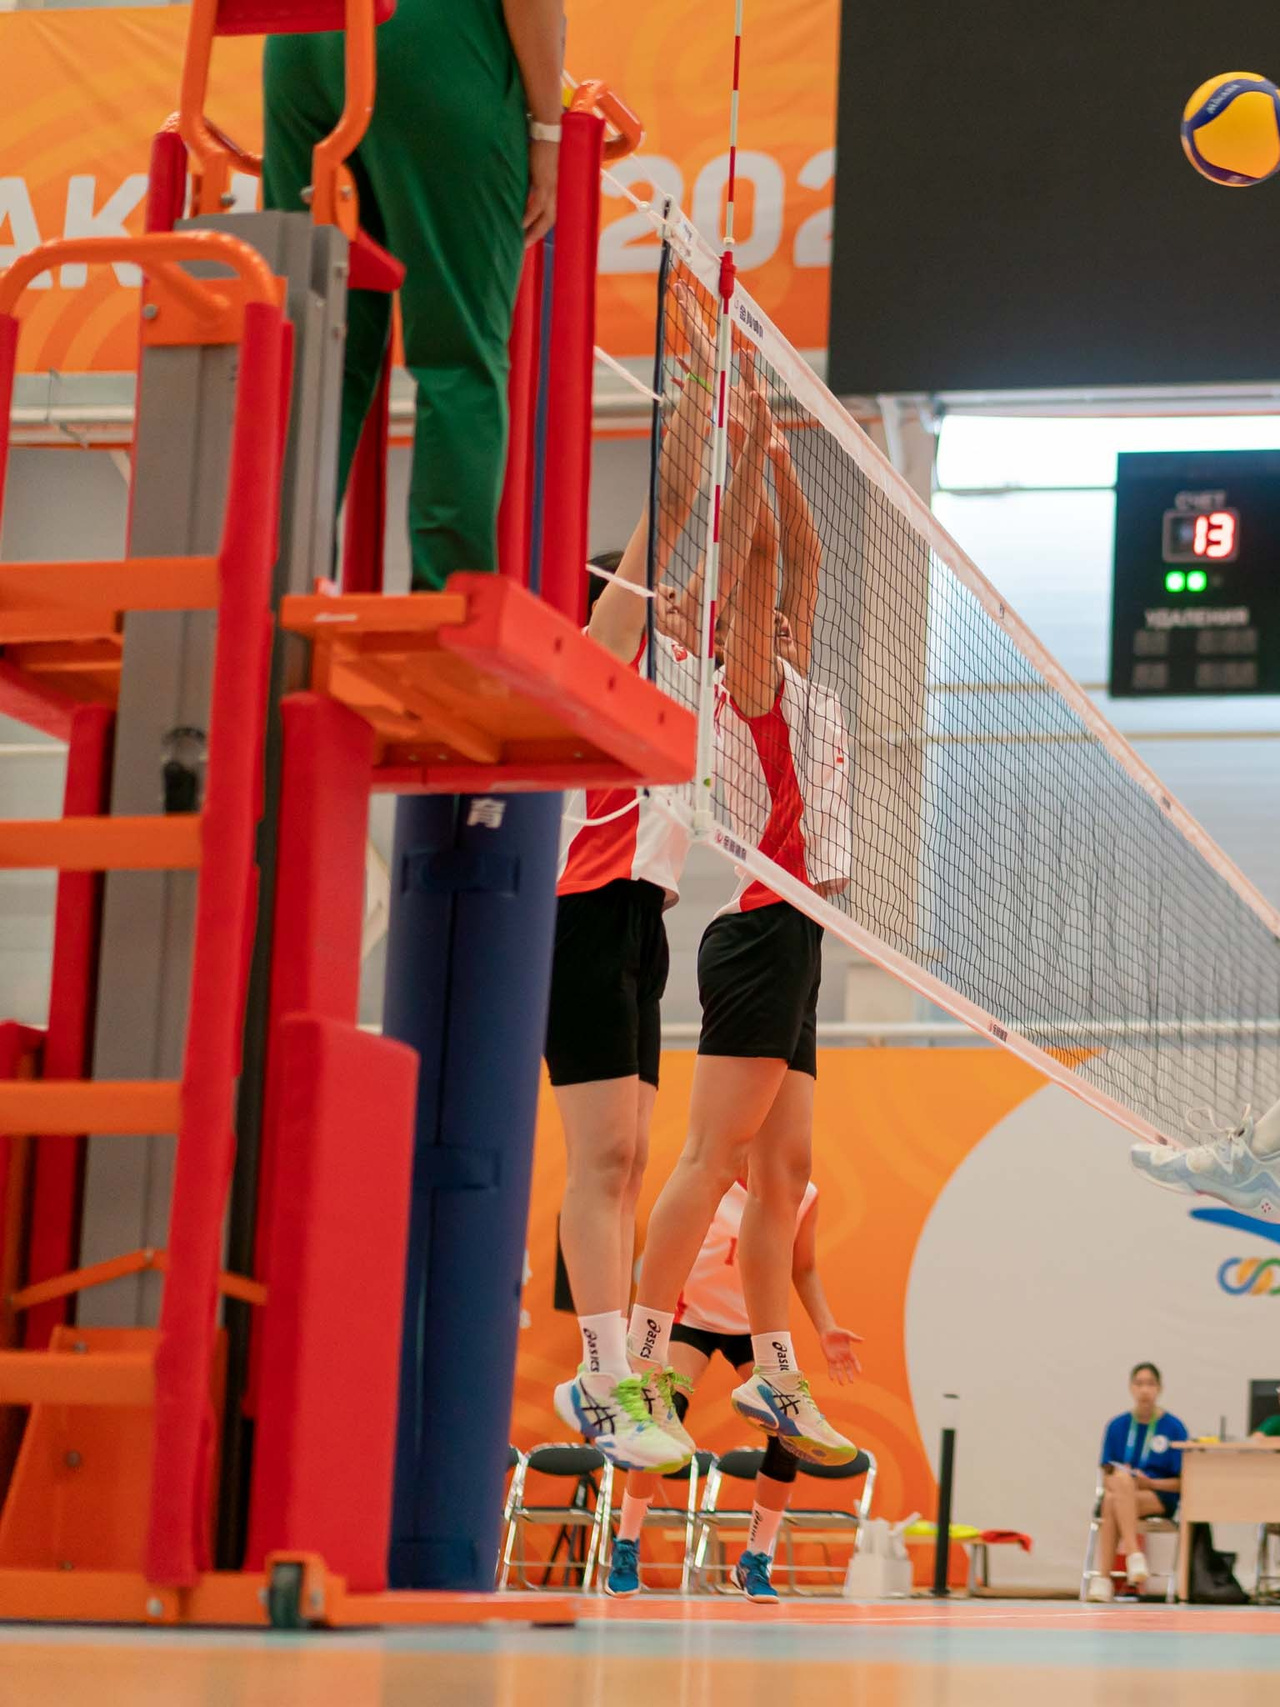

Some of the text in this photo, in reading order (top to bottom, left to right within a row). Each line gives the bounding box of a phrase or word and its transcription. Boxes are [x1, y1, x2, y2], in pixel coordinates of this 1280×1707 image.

[1193, 511, 1236, 559] 13
[584, 1332, 599, 1373] asics
[640, 1325, 660, 1359] asics
